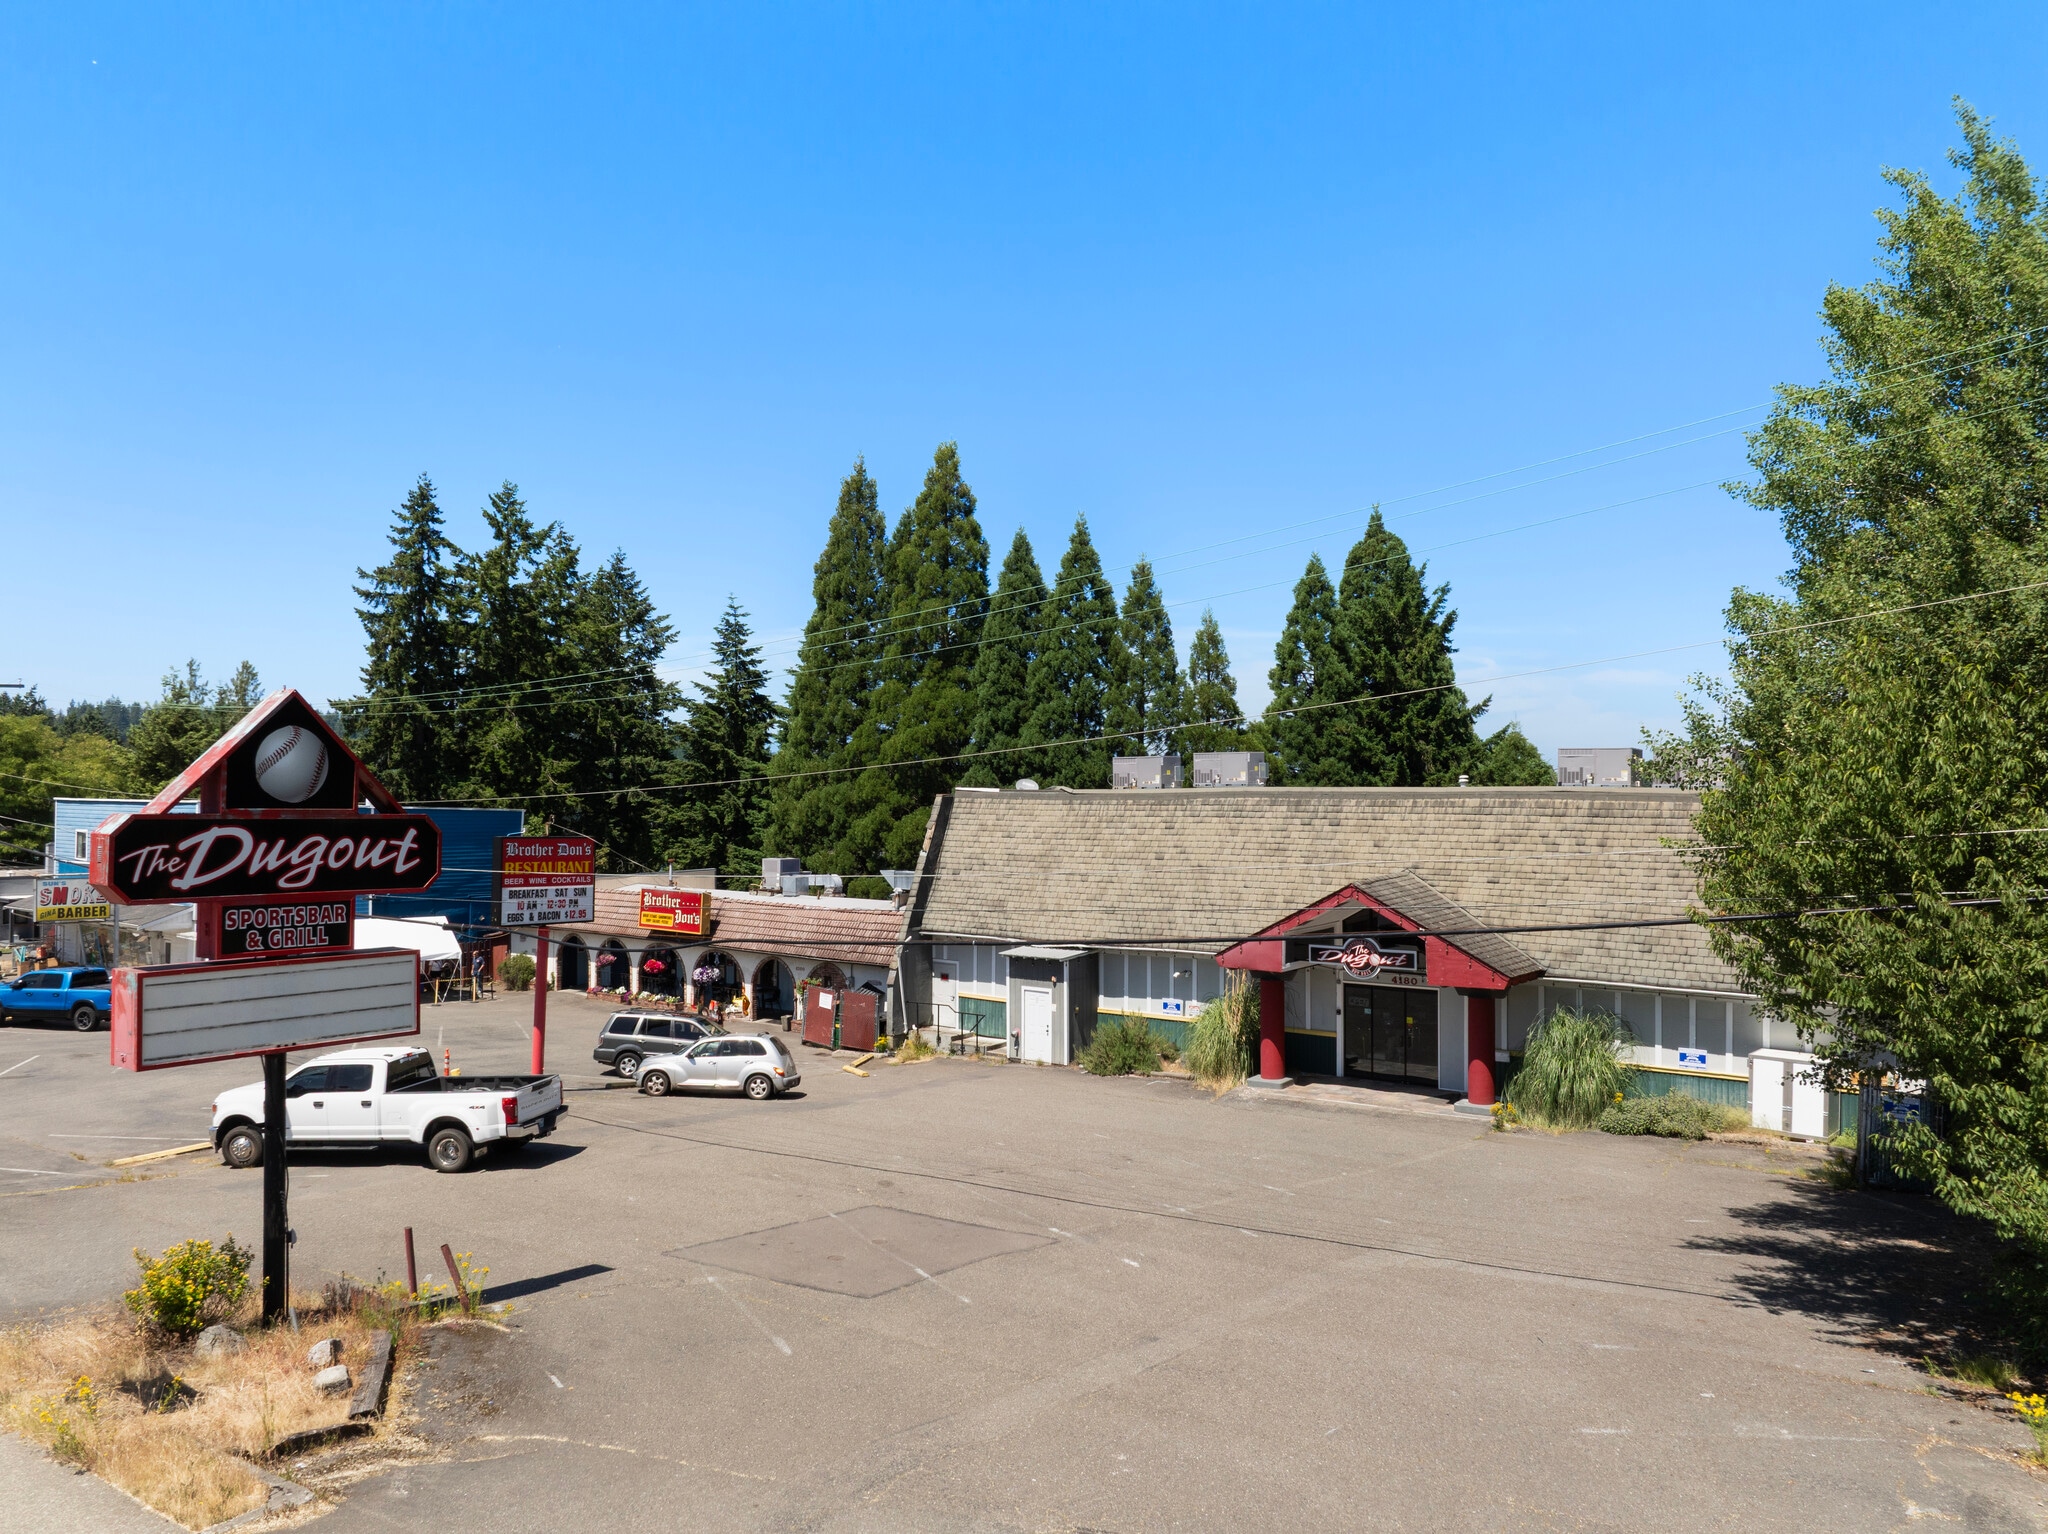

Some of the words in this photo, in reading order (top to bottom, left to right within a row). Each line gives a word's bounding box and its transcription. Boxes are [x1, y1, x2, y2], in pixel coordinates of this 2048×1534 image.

[506, 842, 554, 858] Brother
[557, 842, 592, 857] Don's
[119, 844, 187, 884] The
[169, 825, 420, 891] Dugout
[504, 861, 592, 875] RESTAURANT
[551, 876, 592, 884] COCKTAILS
[508, 888, 549, 900] BREAKFAST
[555, 888, 569, 898] SAT
[573, 888, 587, 897] SUN
[643, 891, 681, 910] Brother
[517, 901, 525, 910] 10
[526, 901, 538, 910] AM
[547, 899, 567, 909] 12:30
[568, 899, 579, 908] PM
[57, 905, 107, 919] BARBER
[224, 904, 347, 931] SPORTSBAR
[507, 912, 525, 923] EGGS
[529, 912, 535, 922] &
[537, 911, 561, 921] BACON
[564, 909, 587, 919] $12.95
[674, 909, 700, 927] Don's
[246, 931, 265, 950] &
[268, 927, 329, 948] GRILL
[1351, 944, 1370, 956] The
[1317, 950, 1407, 968] Dugout
[1391, 975, 1418, 986] 4180
